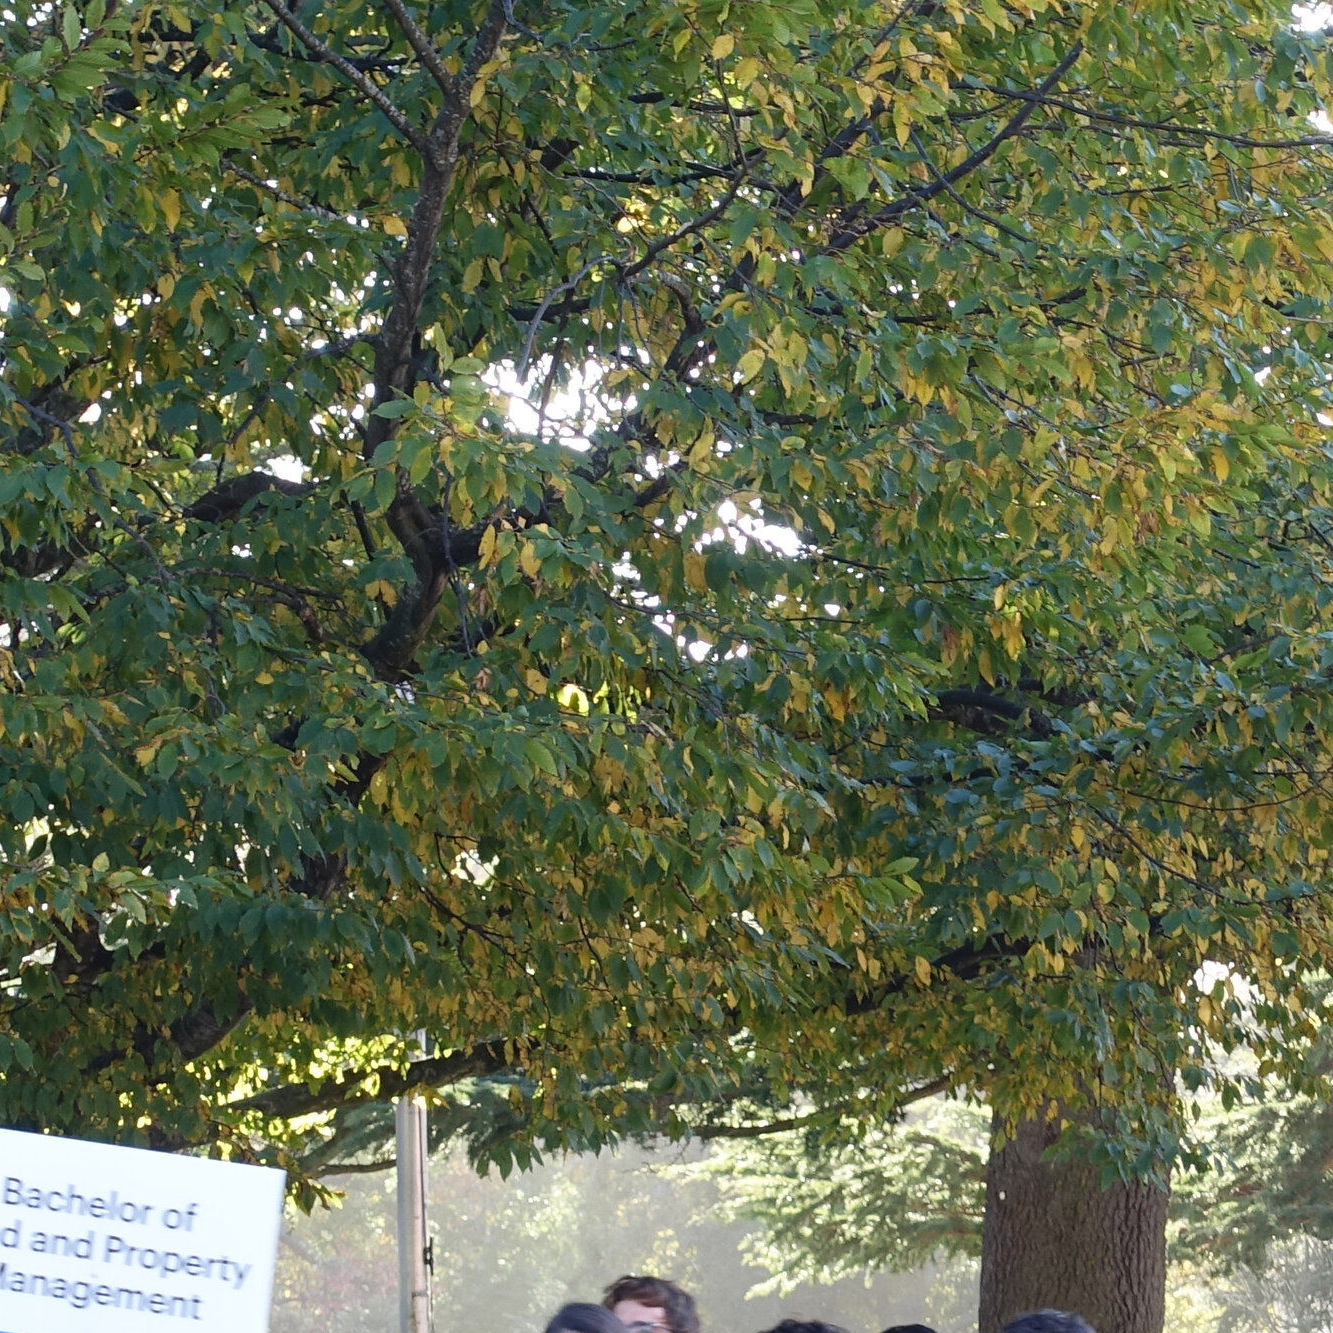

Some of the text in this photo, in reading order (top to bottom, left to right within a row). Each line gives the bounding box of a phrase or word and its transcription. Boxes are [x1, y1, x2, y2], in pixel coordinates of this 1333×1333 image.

[2, 1176, 198, 1232] Bachelor of
[29, 1230, 95, 1261] and
[103, 1235, 253, 1292] Property
